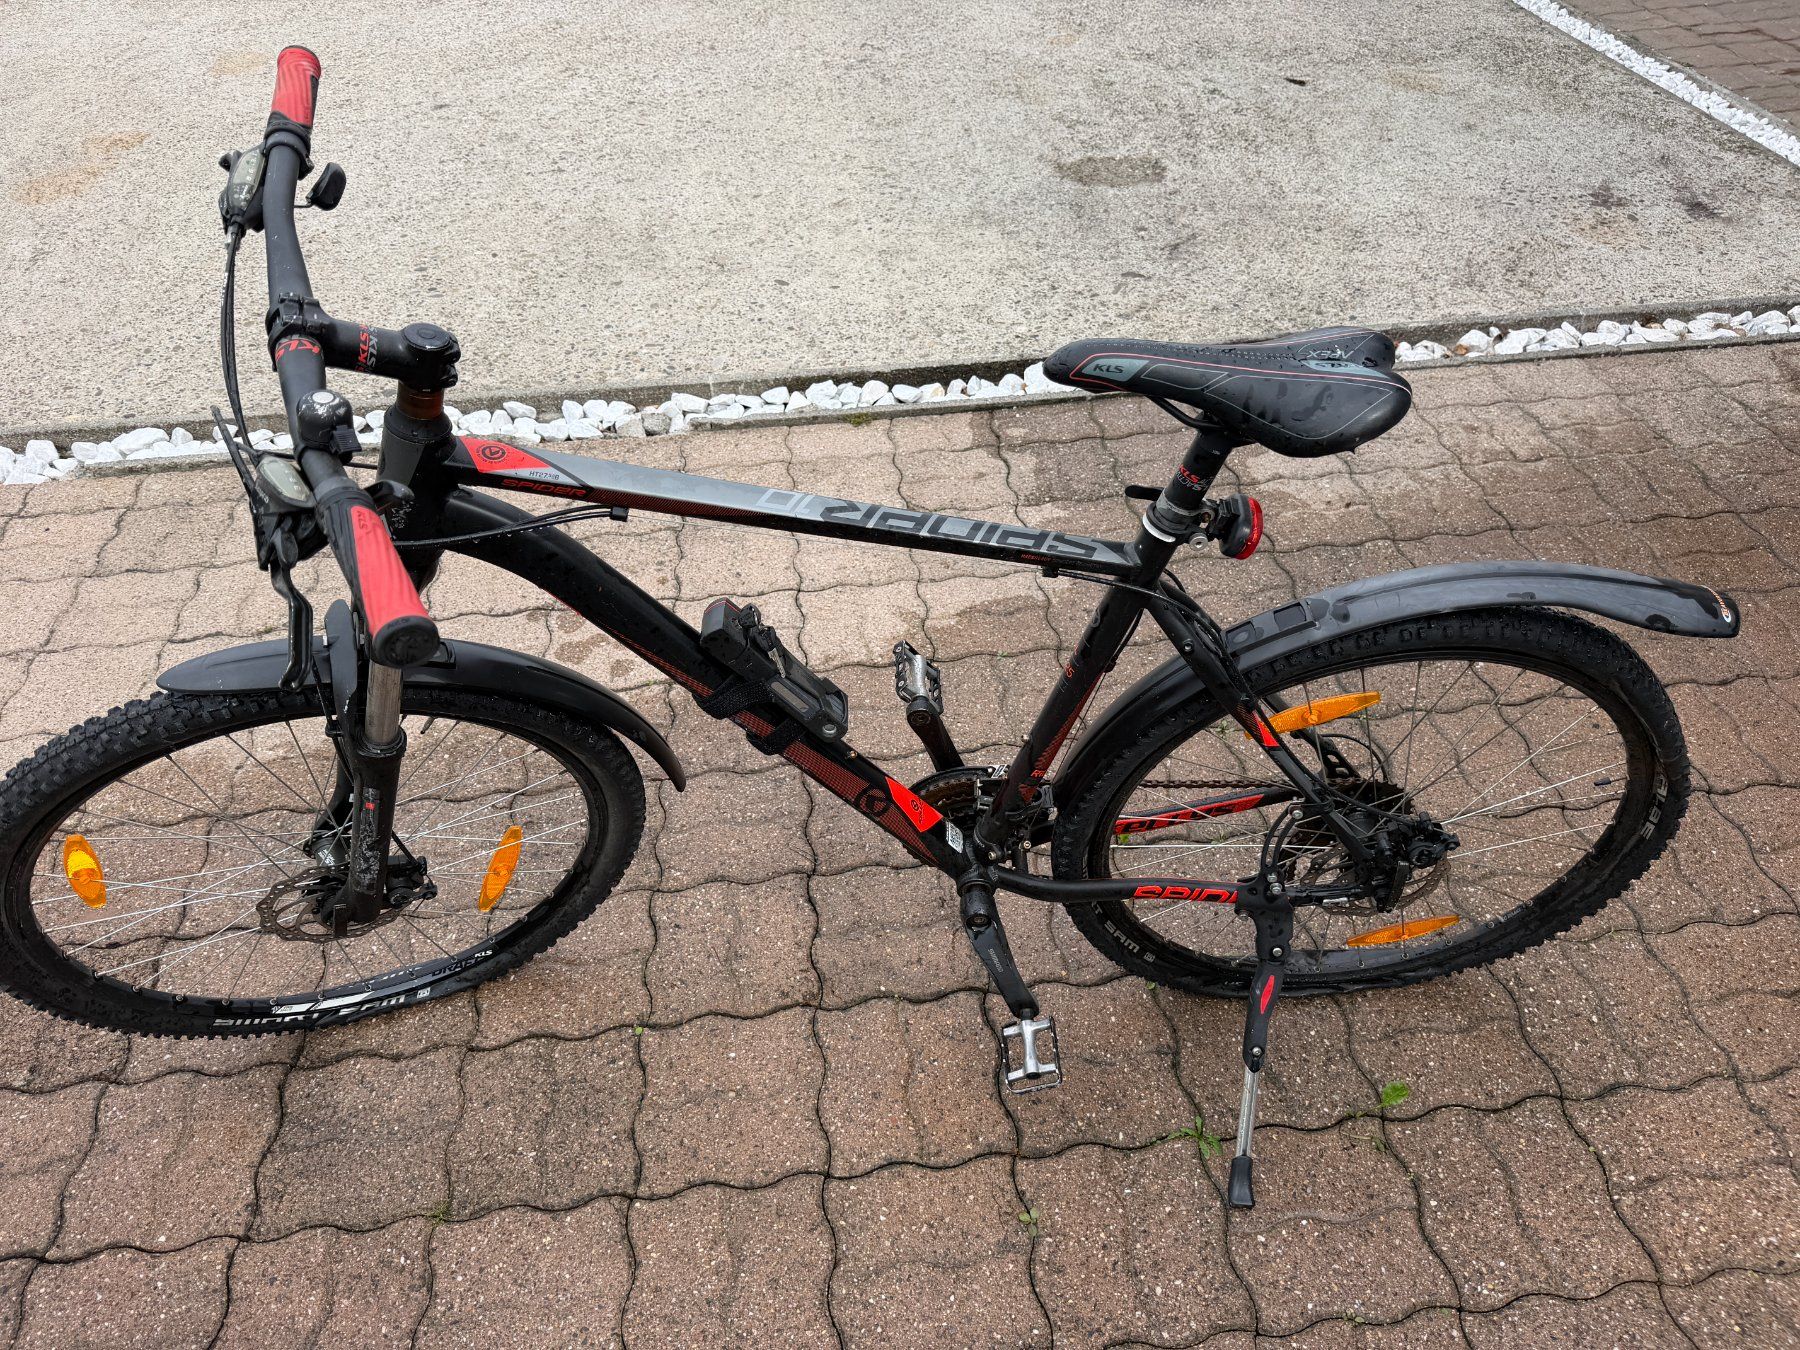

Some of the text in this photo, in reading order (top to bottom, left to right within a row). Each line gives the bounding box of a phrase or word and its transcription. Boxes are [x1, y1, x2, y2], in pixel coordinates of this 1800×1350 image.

[359, 332, 369, 364] KLS
[1093, 363, 1124, 374] KLS
[501, 479, 587, 497] SPIDER
[1133, 886, 1239, 904] SPID
[1104, 920, 1141, 953] SAM
